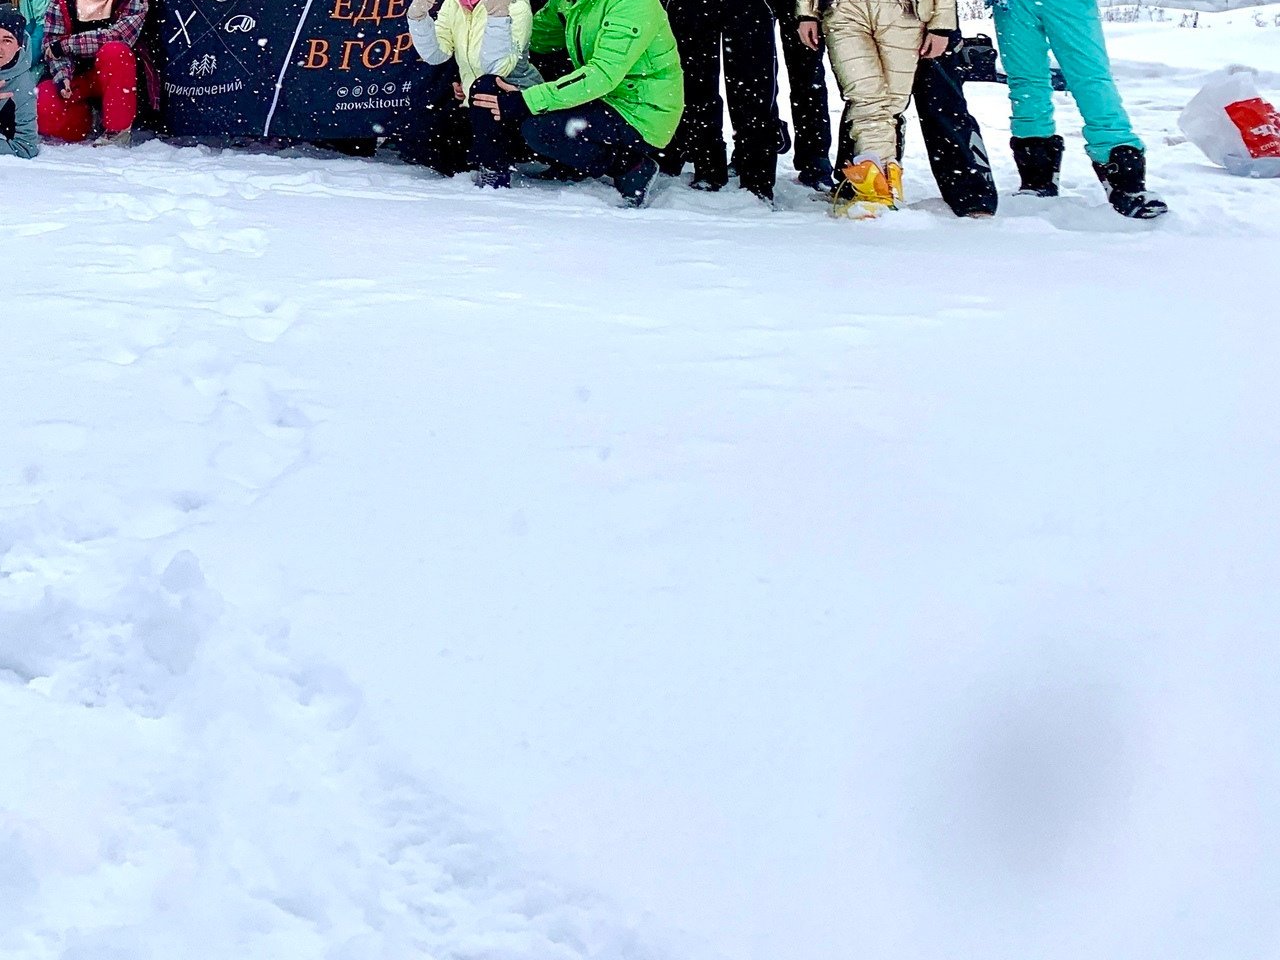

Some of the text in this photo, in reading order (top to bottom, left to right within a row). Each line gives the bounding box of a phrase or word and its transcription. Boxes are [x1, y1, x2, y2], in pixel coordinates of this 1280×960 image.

[303, 32, 424, 70] В ГОР
[164, 78, 243, 98] приключений
[334, 97, 411, 111] snowskitours
